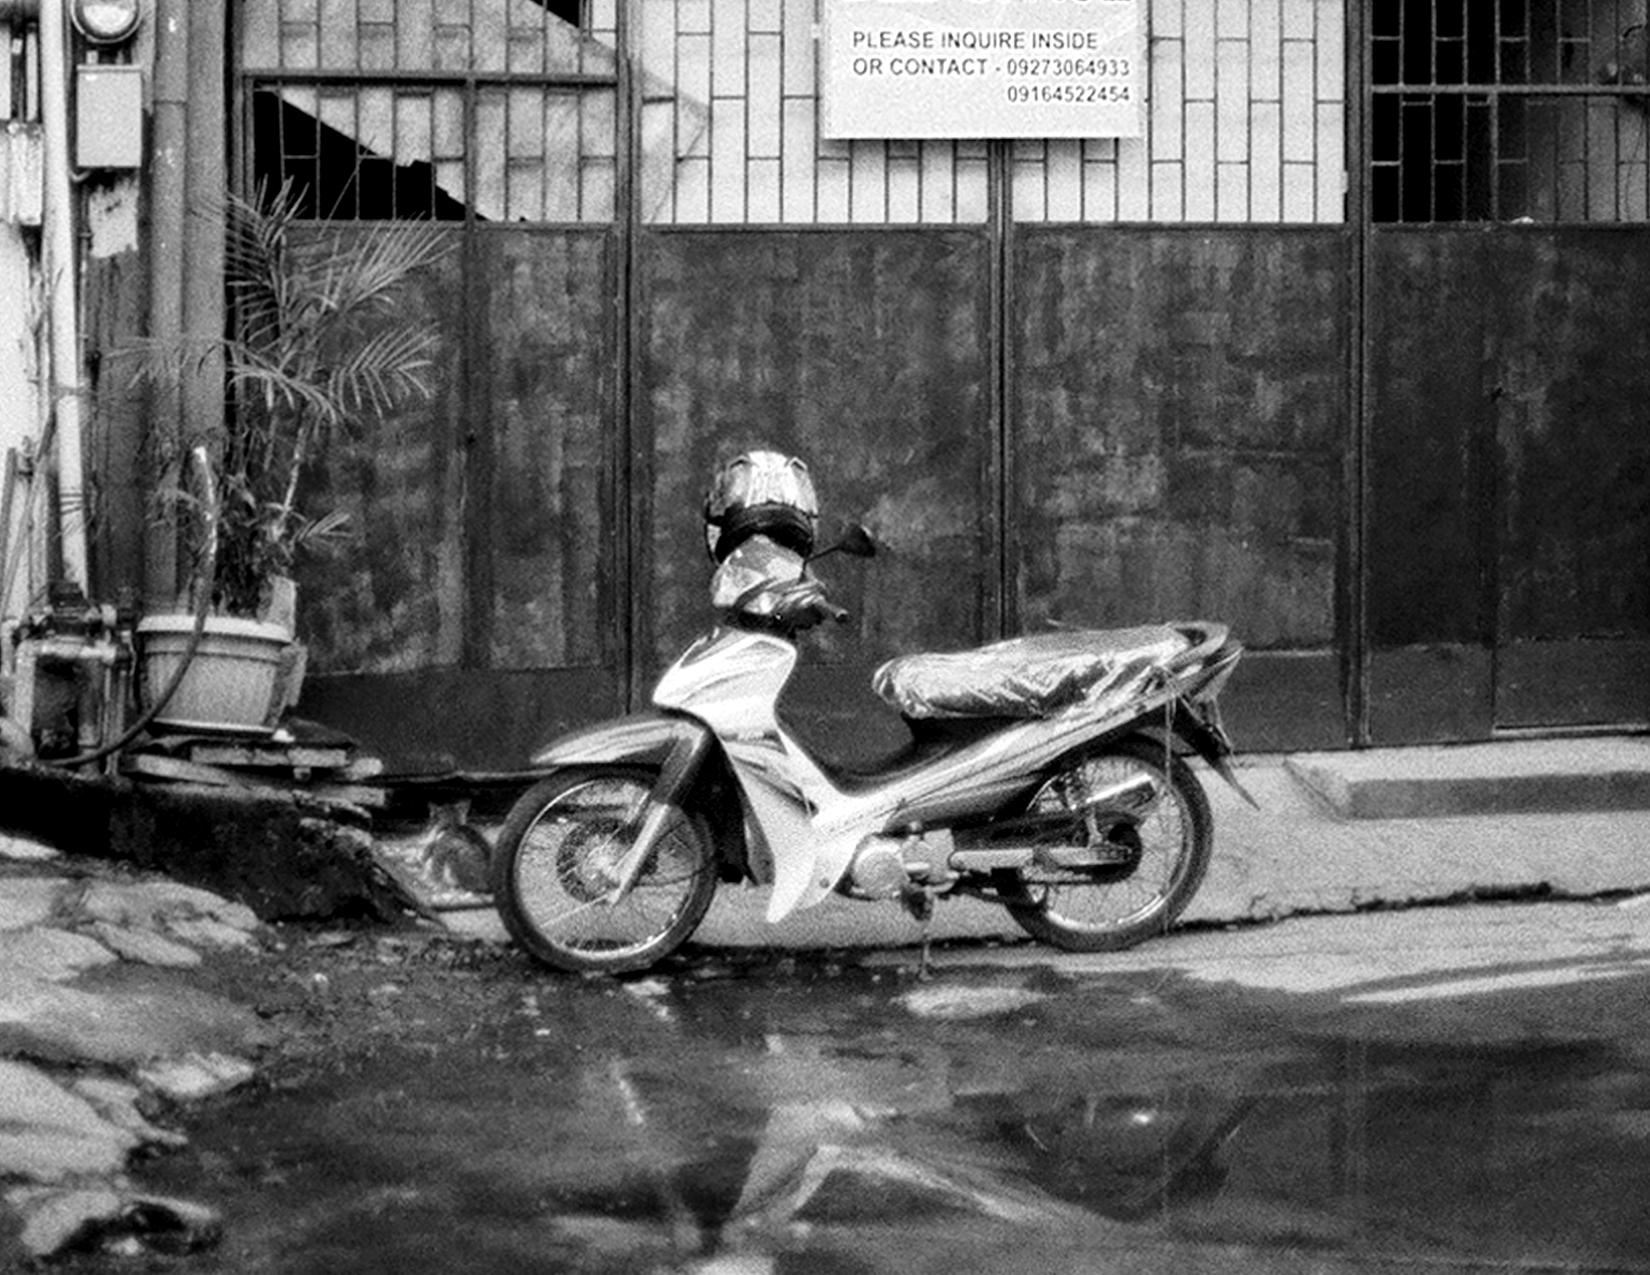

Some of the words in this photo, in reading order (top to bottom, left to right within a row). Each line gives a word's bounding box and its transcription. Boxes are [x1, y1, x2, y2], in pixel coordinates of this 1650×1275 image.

[853, 31, 934, 49] PLEASE
[941, 31, 1026, 50] INQUIRE
[1032, 31, 1098, 50] INSIDE
[853, 58, 882, 76] OR
[890, 58, 988, 76] CONTACT
[1007, 58, 1130, 76] 09273064933
[1007, 85, 1130, 103] 09164522454
